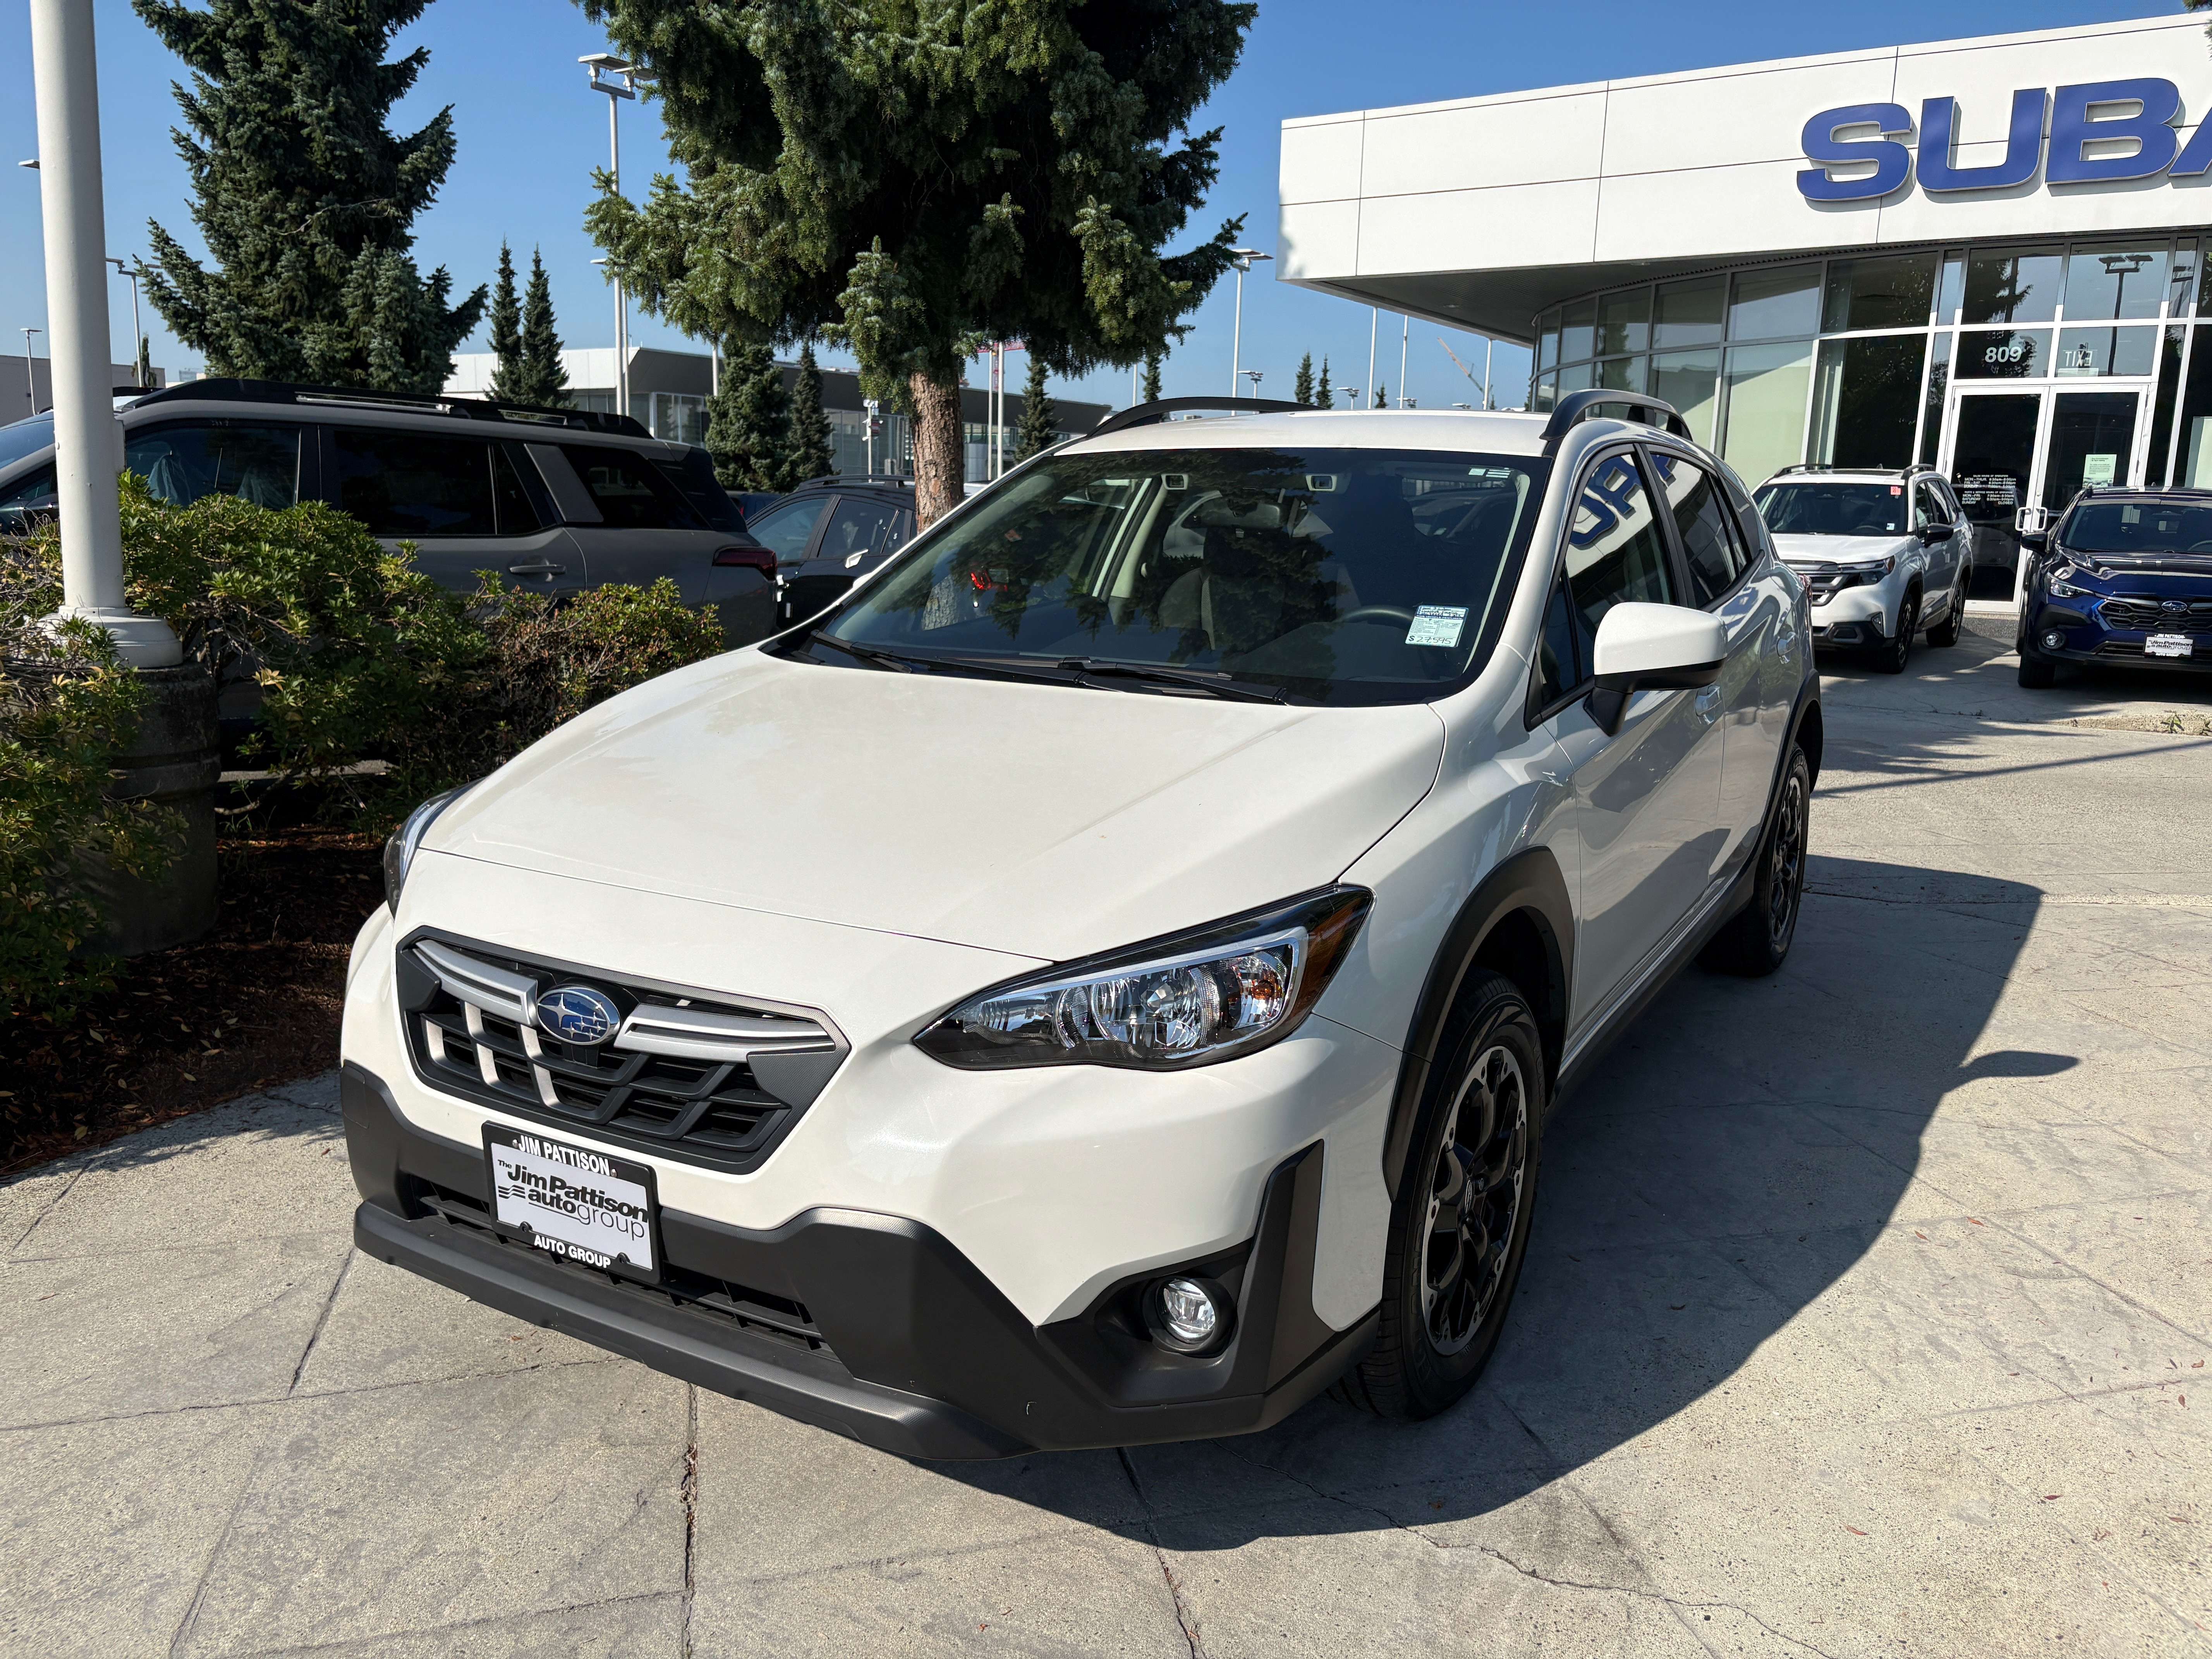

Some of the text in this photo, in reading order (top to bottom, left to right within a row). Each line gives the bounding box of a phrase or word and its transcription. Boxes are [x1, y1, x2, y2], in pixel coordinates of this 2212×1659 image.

[1985, 347, 2022, 362] 809
[498, 1159, 512, 1169] The
[518, 1135, 610, 1176] JIM PATTISON
[534, 1235, 611, 1268] AUTO GROUP
